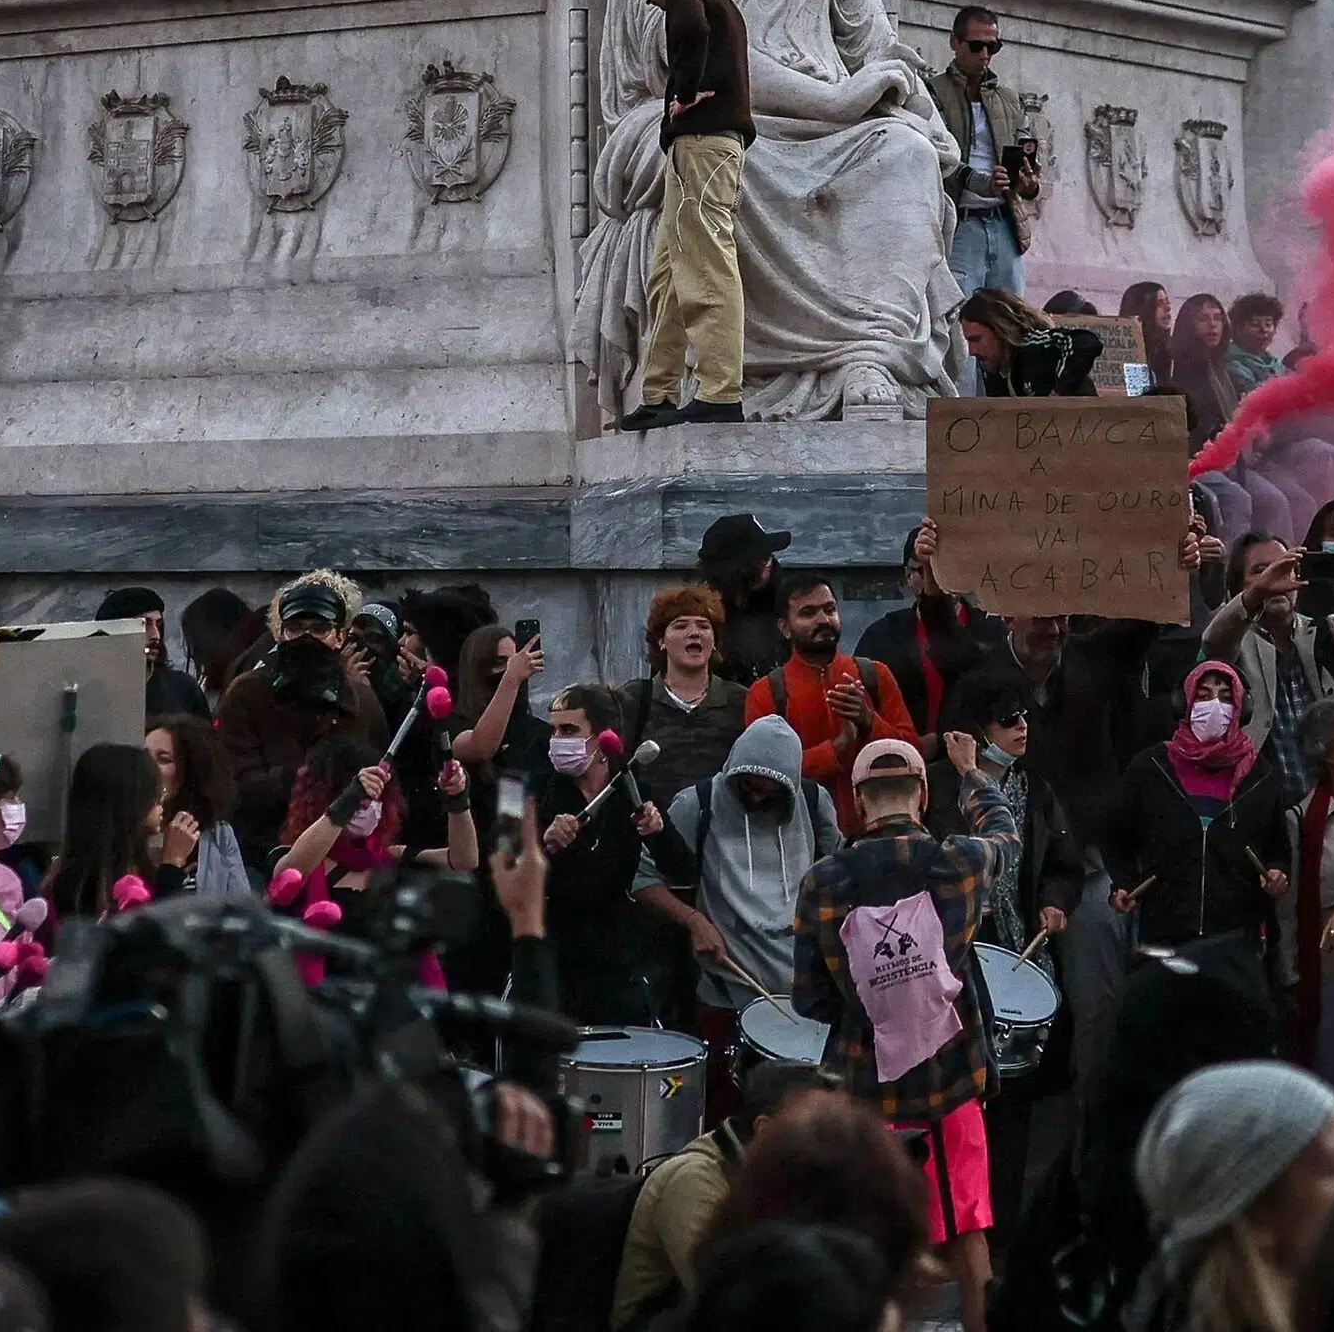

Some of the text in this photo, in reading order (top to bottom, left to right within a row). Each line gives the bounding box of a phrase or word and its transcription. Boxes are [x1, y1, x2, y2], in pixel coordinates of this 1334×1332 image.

[1016, 411, 1158, 450] BANCA
[1029, 456, 1047, 475] A
[942, 486, 1182, 516] MINA DE OURO
[1034, 527, 1081, 550] VAI
[980, 550, 1167, 593] ACABAR
[868, 961, 938, 989] RESISTÊNCIA
[875, 954, 923, 974] RITMOS DE
